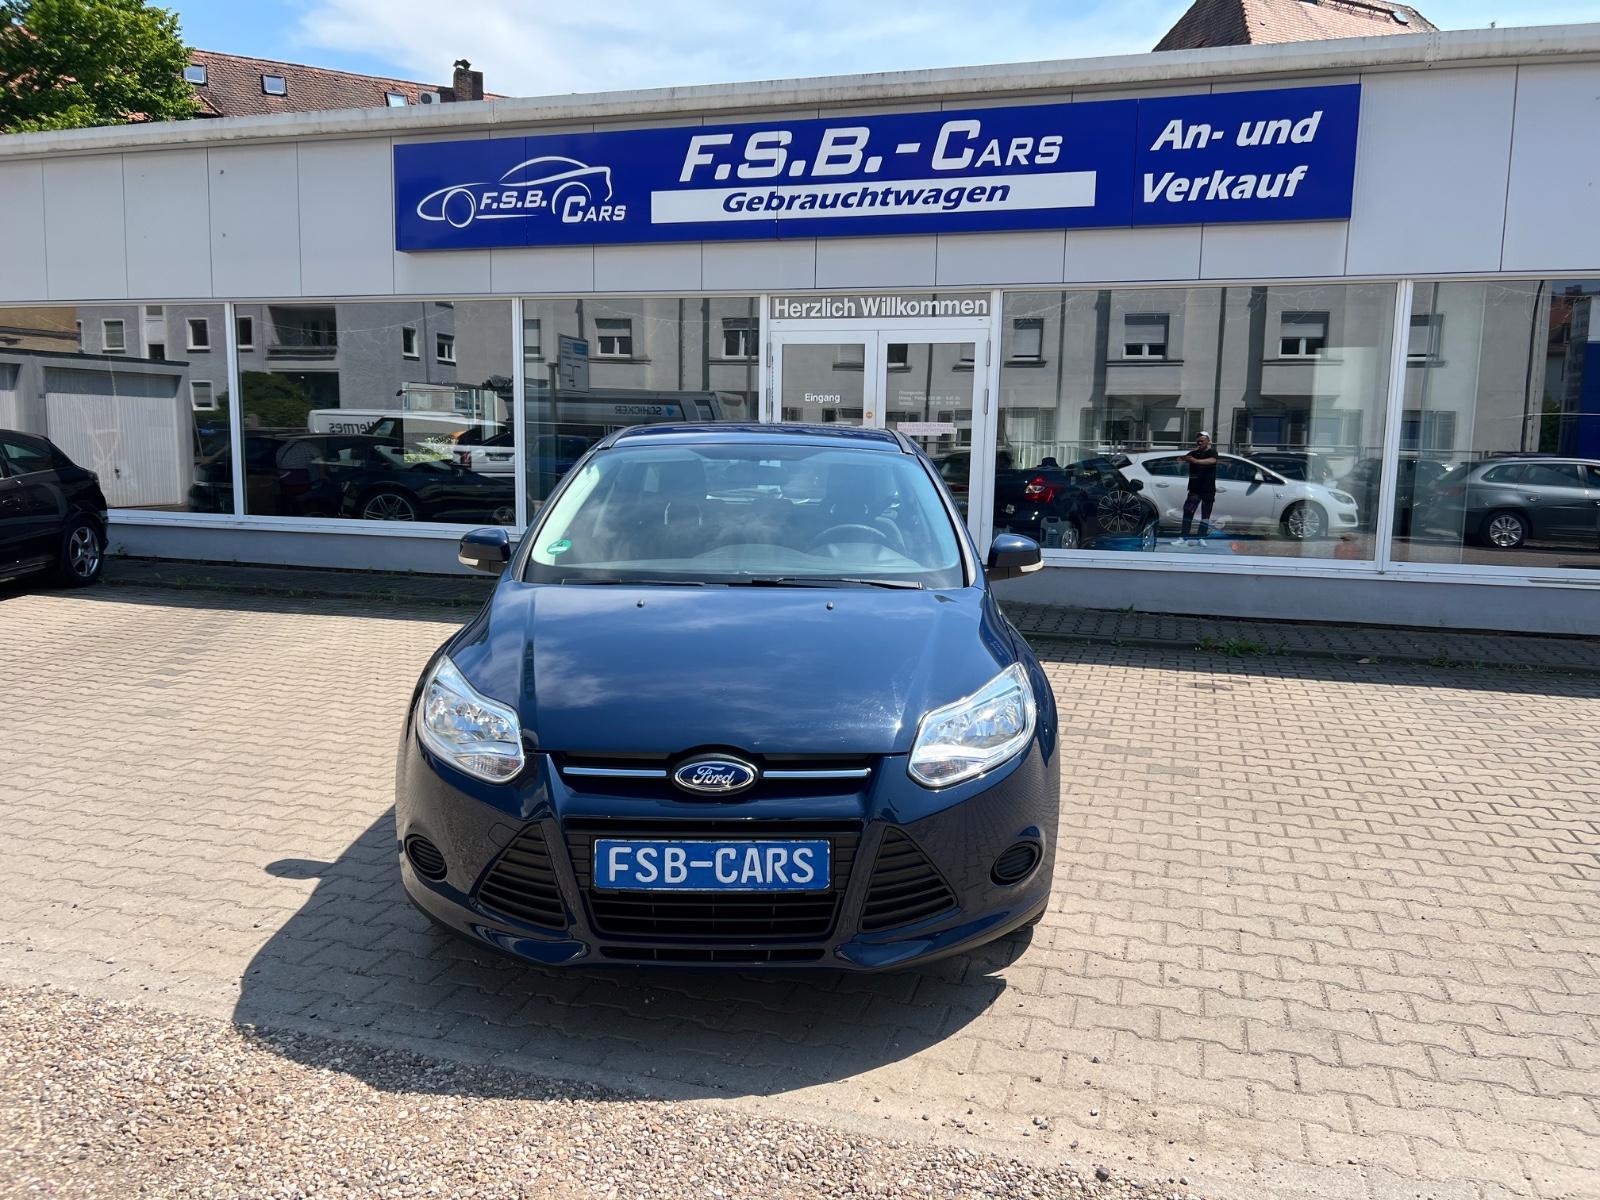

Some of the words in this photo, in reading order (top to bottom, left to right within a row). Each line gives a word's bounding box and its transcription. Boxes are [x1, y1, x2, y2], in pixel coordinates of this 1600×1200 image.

[1149, 119, 1224, 152] An-
[1235, 110, 1324, 147] und
[1143, 165, 1309, 203] Verkauf
[480, 190, 548, 210] F.S.B.
[722, 183, 1012, 214] Gebrauchtwagen
[774, 296, 856, 318] Herzlich
[859, 294, 988, 317] Willkommen
[804, 392, 841, 404] Eingang
[692, 765, 735, 787] Ford
[608, 846, 815, 884] FSB-CARS
